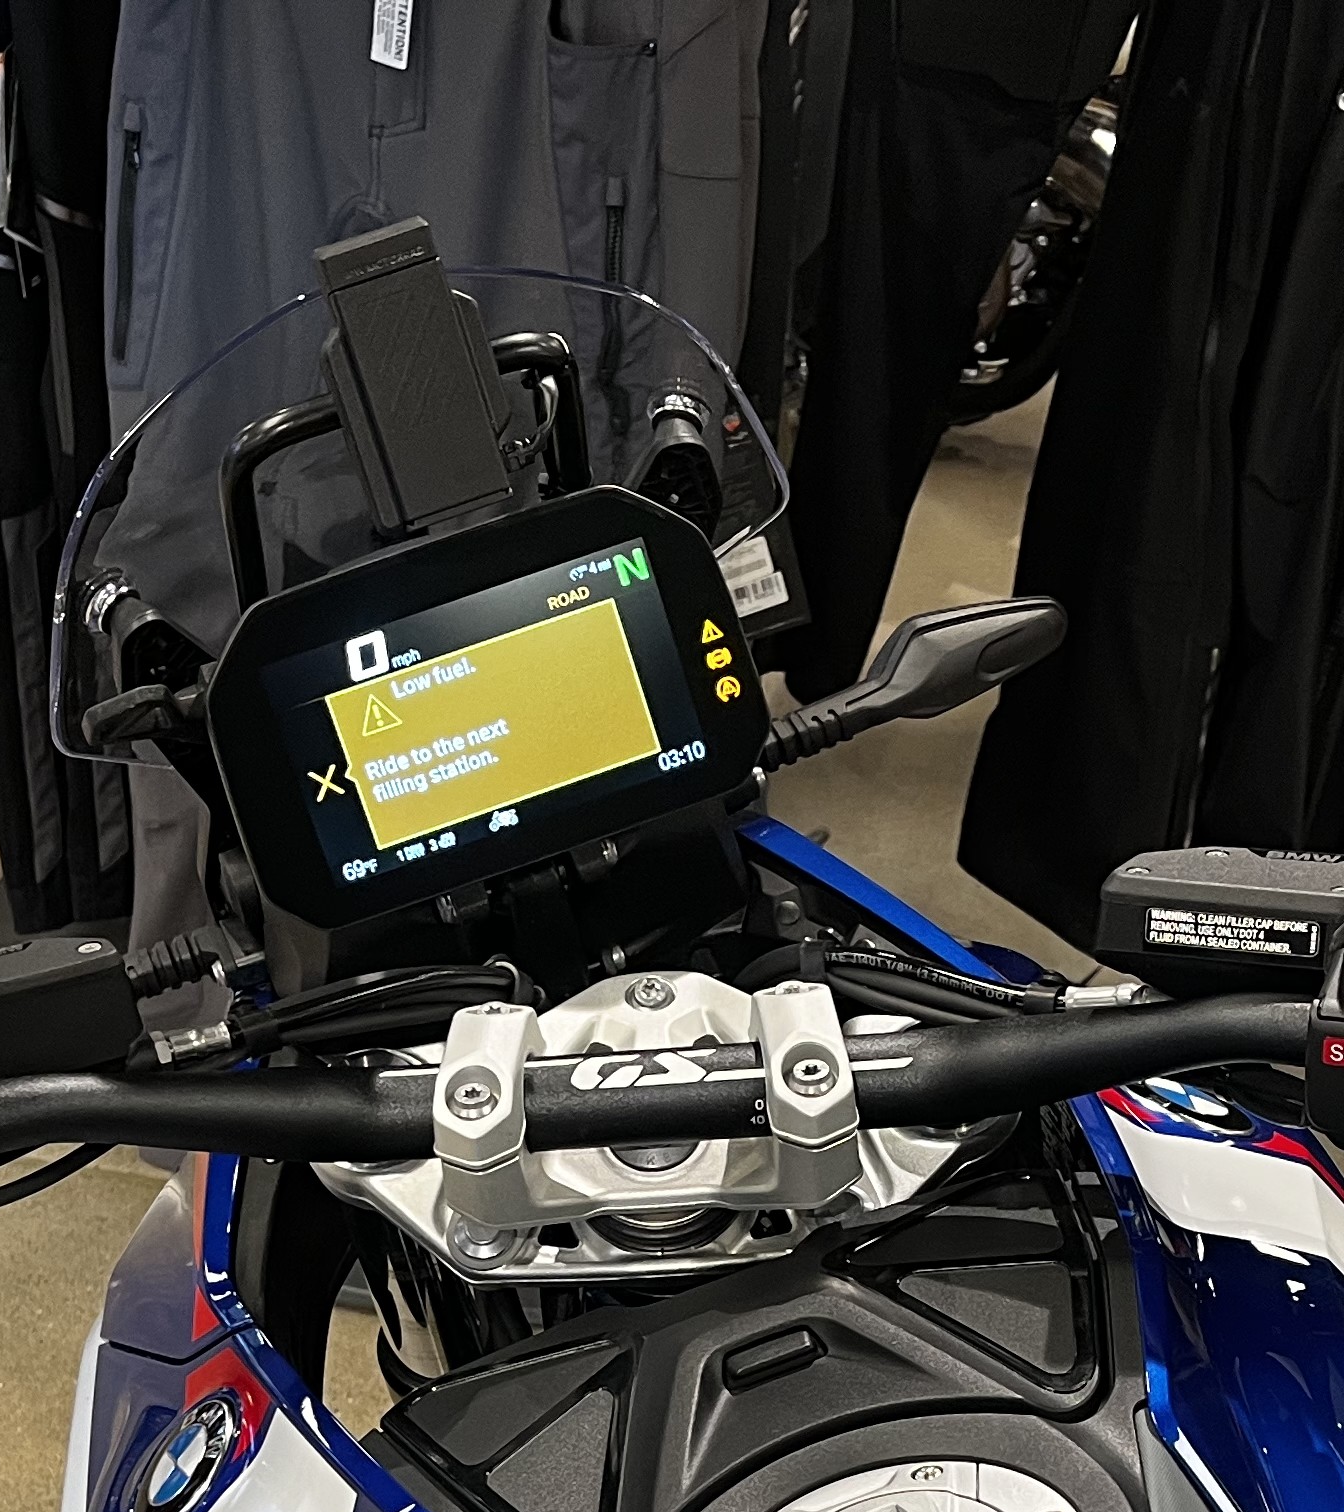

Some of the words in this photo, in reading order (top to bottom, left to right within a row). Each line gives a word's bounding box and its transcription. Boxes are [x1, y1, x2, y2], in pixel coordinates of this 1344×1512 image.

[612, 547, 650, 587] N
[546, 586, 591, 611] ROAD
[346, 629, 390, 682] 0
[391, 648, 422, 669] mph
[390, 673, 432, 699] Low
[432, 656, 477, 685] fuel.
[364, 754, 410, 781] Ride
[410, 747, 433, 765] to
[432, 736, 466, 758] the
[466, 718, 510, 746] next
[658, 740, 706, 771] 03:10
[372, 773, 429, 803] filling
[428, 750, 500, 784] station.
[1266, 850, 1342, 863] BMW
[1150, 908, 1196, 923] WARNING:
[1197, 913, 1226, 926] CLEAN
[1226, 916, 1255, 929] FILLER
[1255, 918, 1273, 930] CAP
[1273, 920, 1309, 933] BEFORE
[1197, 924, 1215, 936] USE
[1215, 926, 1240, 939] ONLY
[1239, 928, 1258, 940] DOT
[1149, 930, 1175, 944] FLUID
[1174, 933, 1200, 946] FROM
[1206, 936, 1240, 950] SEALED
[1240, 939, 1292, 954] CONTAINER.
[570, 1049, 717, 1091] GS
